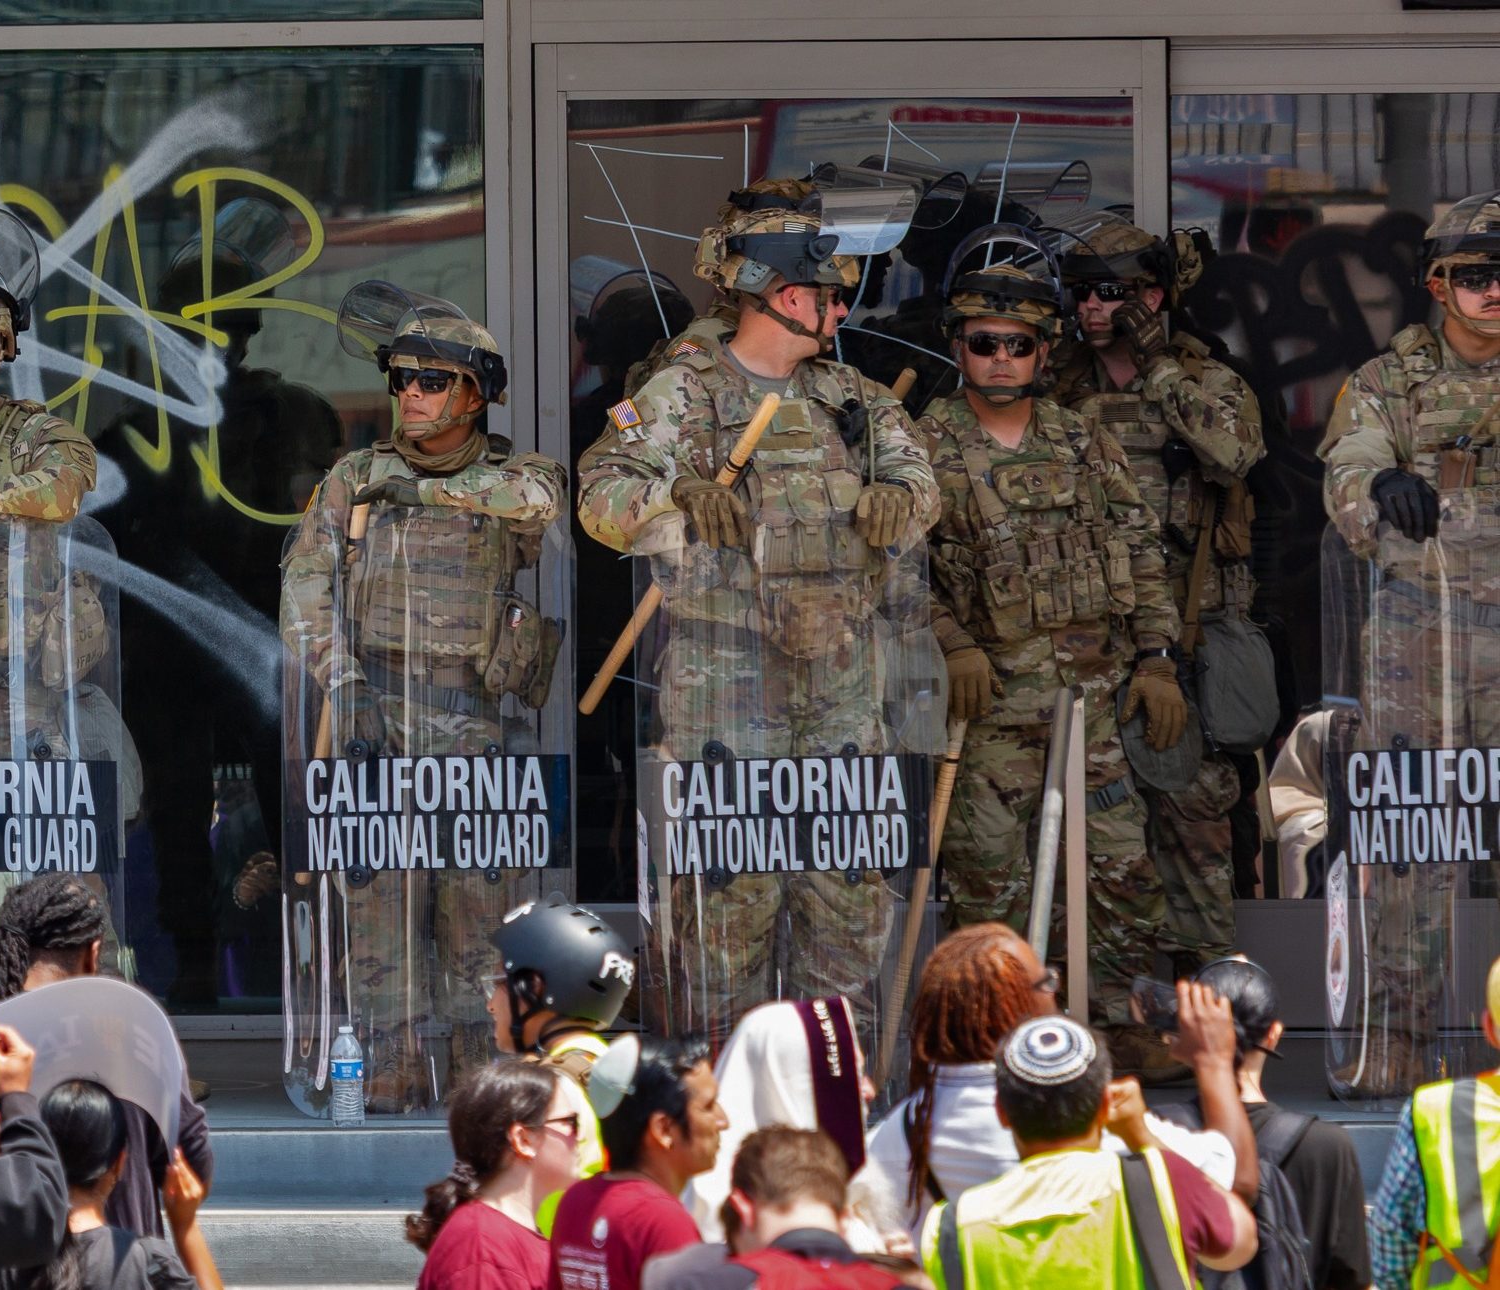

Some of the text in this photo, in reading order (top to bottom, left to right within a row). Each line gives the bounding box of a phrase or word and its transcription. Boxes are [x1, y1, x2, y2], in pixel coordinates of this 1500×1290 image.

[305, 756, 548, 815] CALIFORNIA
[662, 755, 907, 818] CALIFORNIA
[4, 817, 97, 873] GUARD
[307, 813, 550, 871] NATIONAL GUARD
[665, 816, 805, 875] NATIONAL
[811, 813, 909, 871] GUARD
[1349, 807, 1491, 865] NATIONAL
